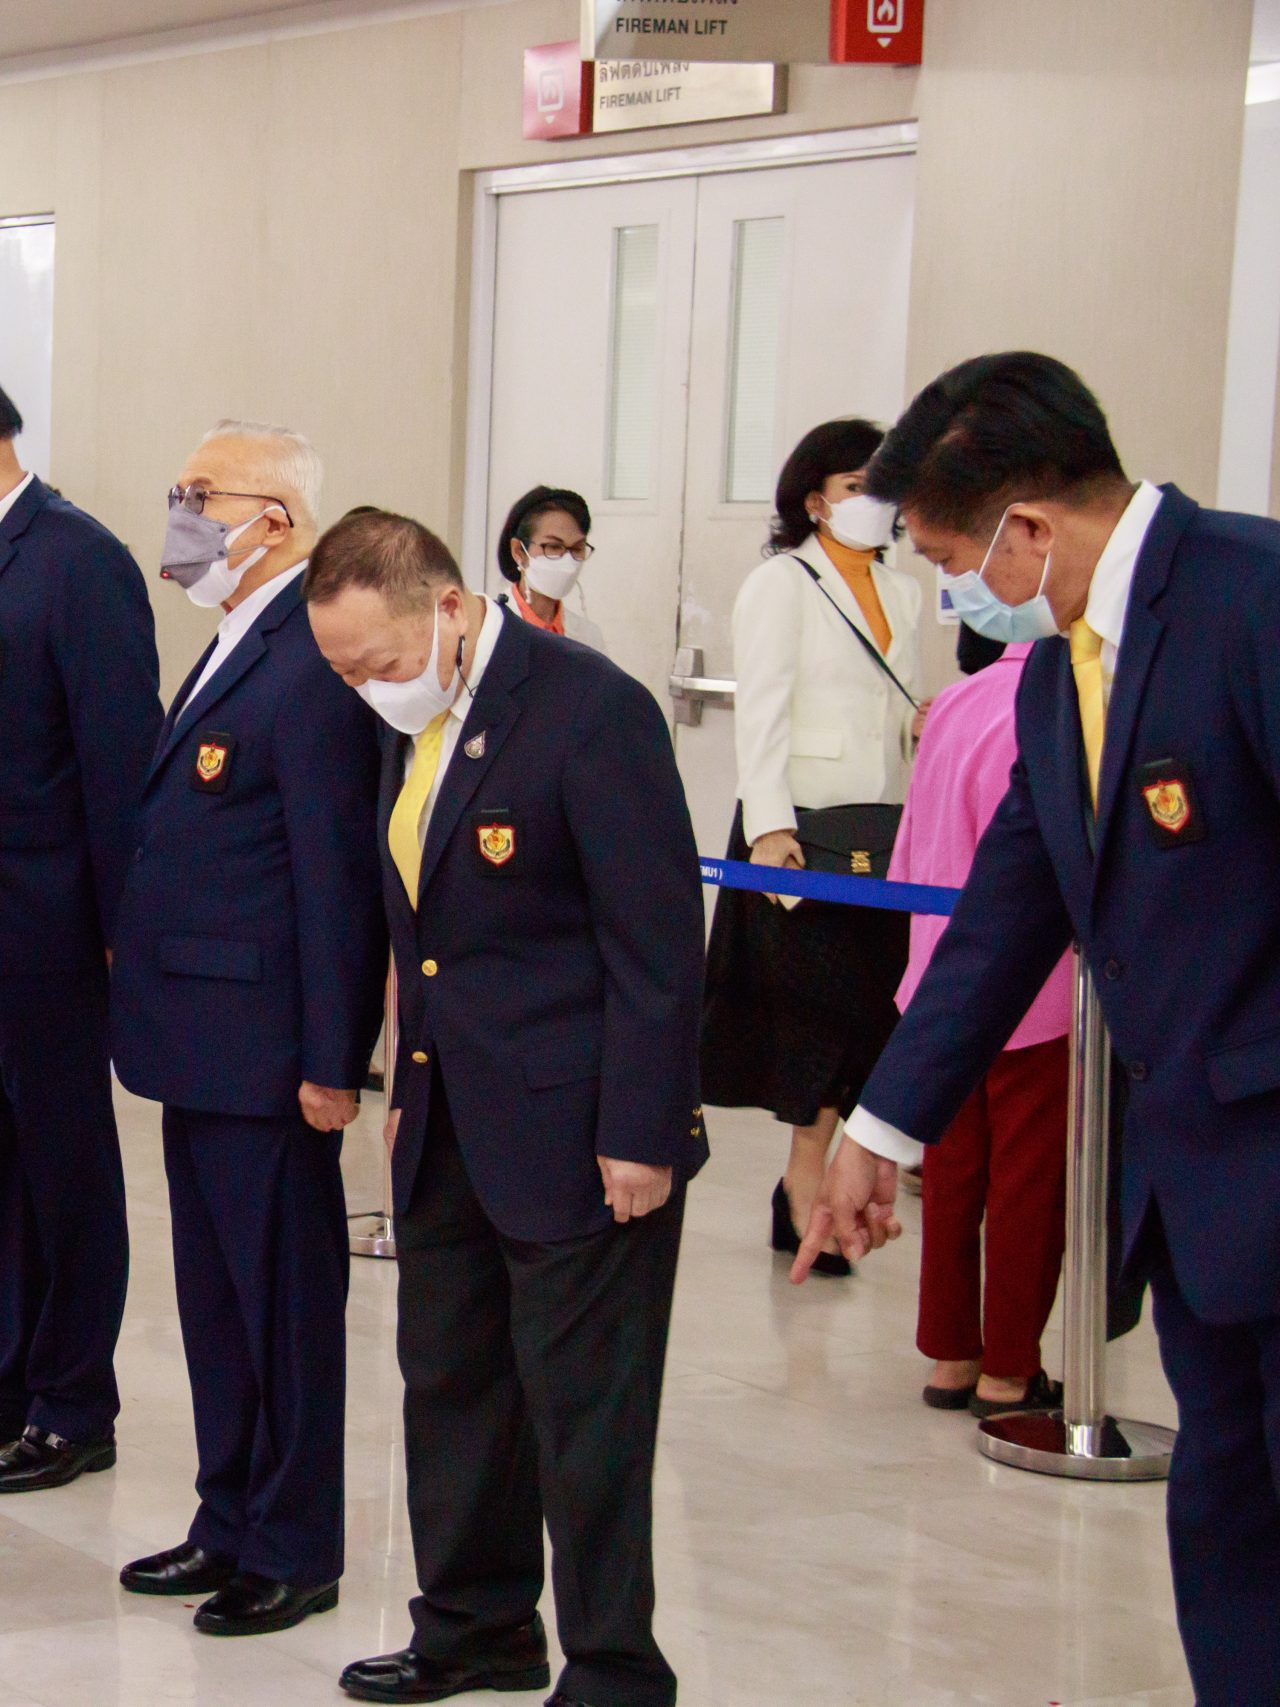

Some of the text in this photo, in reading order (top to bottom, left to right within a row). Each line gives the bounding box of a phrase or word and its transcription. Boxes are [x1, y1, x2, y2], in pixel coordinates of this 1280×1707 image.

[616, 18, 728, 35] FIREMAN LIFT
[600, 86, 682, 109] FIREMAN LIFT
